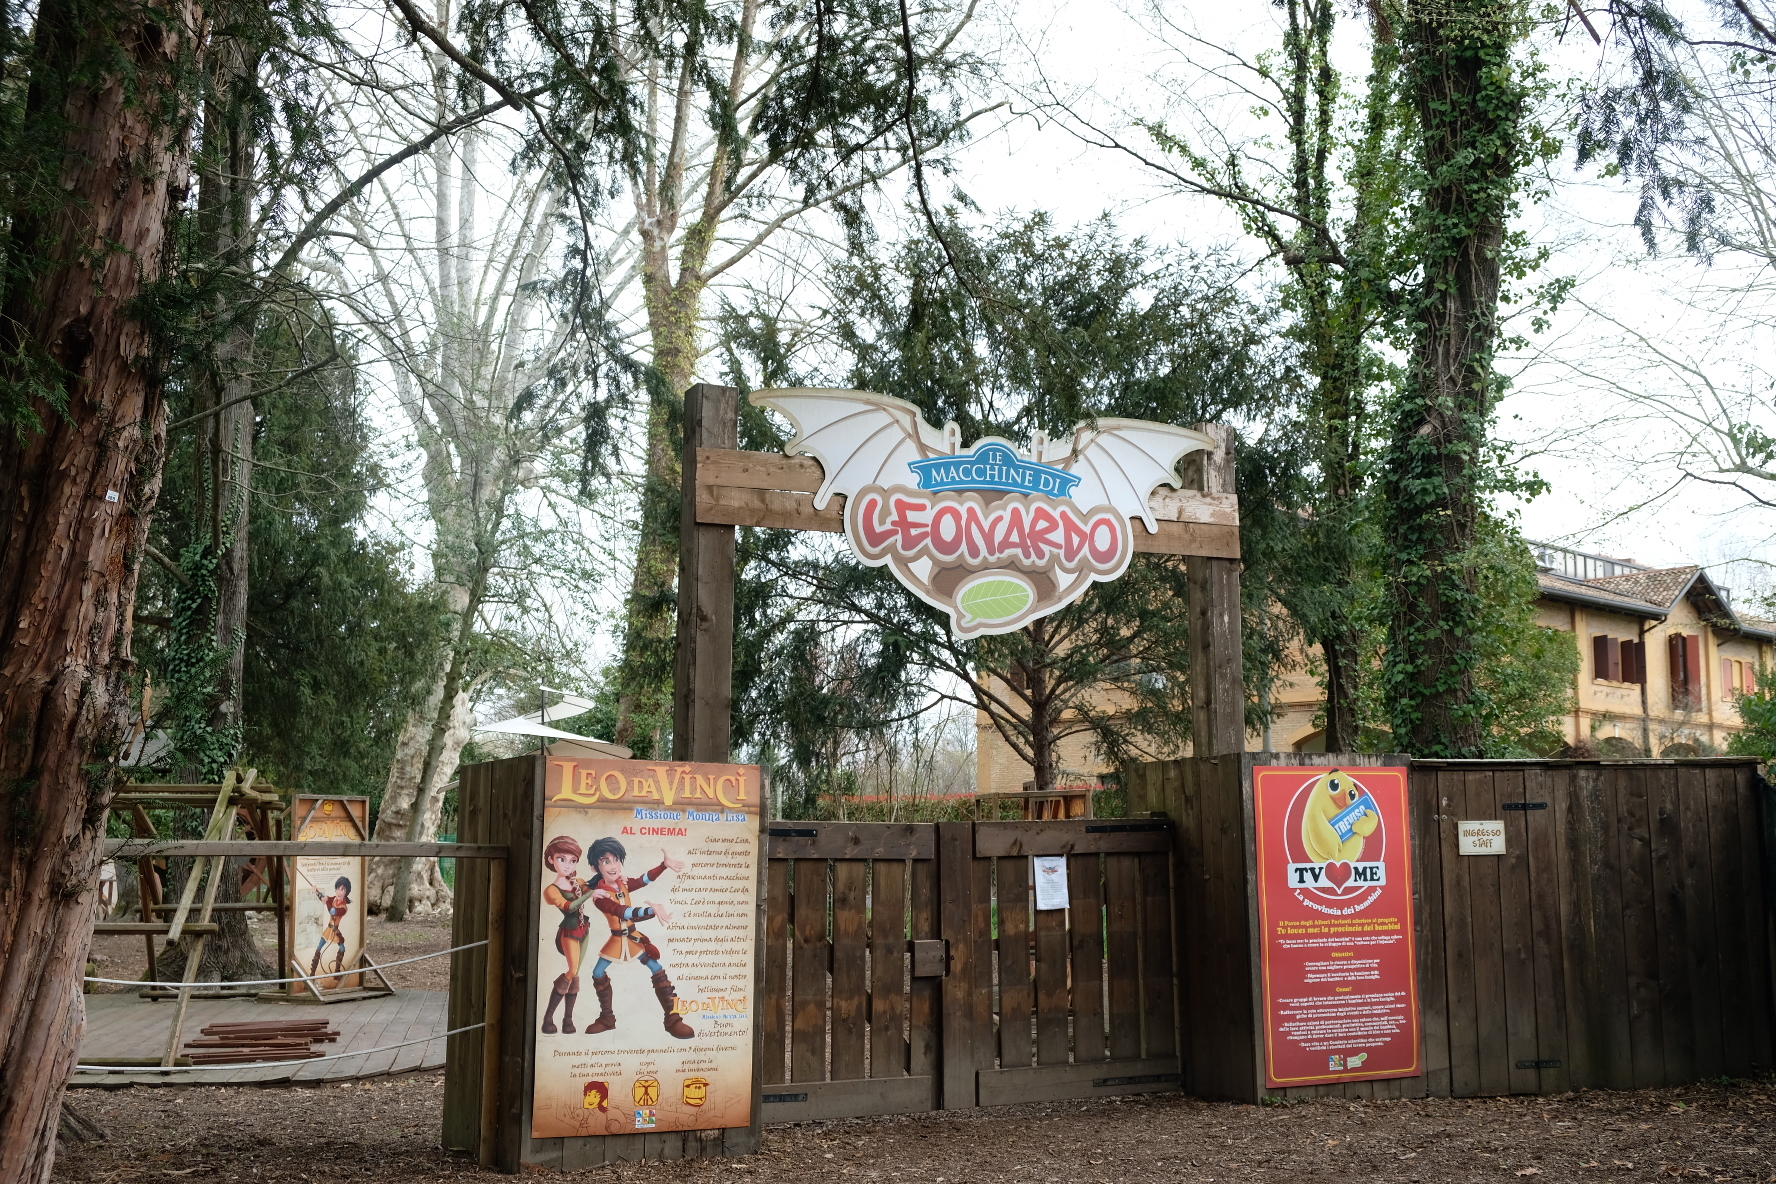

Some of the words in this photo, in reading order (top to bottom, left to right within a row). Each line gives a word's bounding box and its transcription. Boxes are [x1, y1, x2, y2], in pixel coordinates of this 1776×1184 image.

[989, 452, 1003, 464] LE
[931, 463, 1034, 487] MACCHINE
[1039, 473, 1060, 494] DI
[862, 498, 1119, 566] LEONARDO
[552, 761, 627, 804] LEO
[632, 777, 660, 800] DA
[647, 764, 747, 808] VINCI
[634, 807, 681, 821] Missione
[686, 809, 720, 823] Monna
[725, 810, 747, 823] Lisa
[1335, 805, 1366, 835] TREVISO
[621, 826, 636, 835] AL
[639, 826, 688, 837] CINEMA!
[1463, 829, 1501, 838] INGRESSO
[705, 836, 721, 844] Ciao
[735, 836, 751, 845] Lisa,
[1472, 838, 1494, 848] STAFF
[687, 848, 723, 856] all'interno
[724, 848, 730, 859] di
[731, 851, 751, 859] questo
[691, 862, 716, 872] percorso
[716, 861, 744, 869] troverete
[745, 861, 750, 869] le
[677, 872, 718, 885] affascinanti
[719, 873, 750, 881] macchine
[1294, 866, 1324, 884] TV
[1353, 866, 1381, 883] ME
[671, 885, 681, 896] del
[741, 886, 749, 896] da
[690, 898, 702, 906] Leo
[702, 898, 706, 906] è
[717, 898, 736, 910] genio,
[1294, 889, 1304, 902] La
[1304, 899, 1342, 916] provincia
[1343, 906, 1355, 915] dei
[1355, 887, 1383, 911] bambini
[667, 923, 686, 931] abbia
[687, 923, 720, 931] inventato
[1330, 924, 1363, 934] provincia
[1375, 923, 1401, 931] bambini
[667, 937, 693, 947] pensato
[693, 936, 713, 946] prima
[714, 935, 729, 947] degli
[730, 935, 748, 943] altri!
[684, 950, 698, 960] poco
[698, 949, 721, 960] potrete
[722, 948, 741, 957] vedere
[728, 960, 747, 968] anche
[677, 973, 685, 981] al
[685, 973, 709, 981] cinema
[698, 985, 728, 994] bellissimo
[729, 984, 747, 997] film!
[669, 997, 700, 1015] LEO
[701, 1001, 713, 1012] DA
[707, 995, 748, 1014] VINCI
[714, 1020, 734, 1029] Buon
[698, 1028, 749, 1040] divertimento!
[553, 1049, 583, 1058] Durante
[590, 1049, 616, 1061] percorso
[646, 1046, 676, 1058] pannelli
[693, 1045, 715, 1056] disegni
[604, 1062, 622, 1071] prova
[639, 1060, 656, 1069] scopri
[682, 1059, 696, 1069] gioca
[591, 1070, 623, 1078] creatività
[636, 1068, 645, 1076] chi
